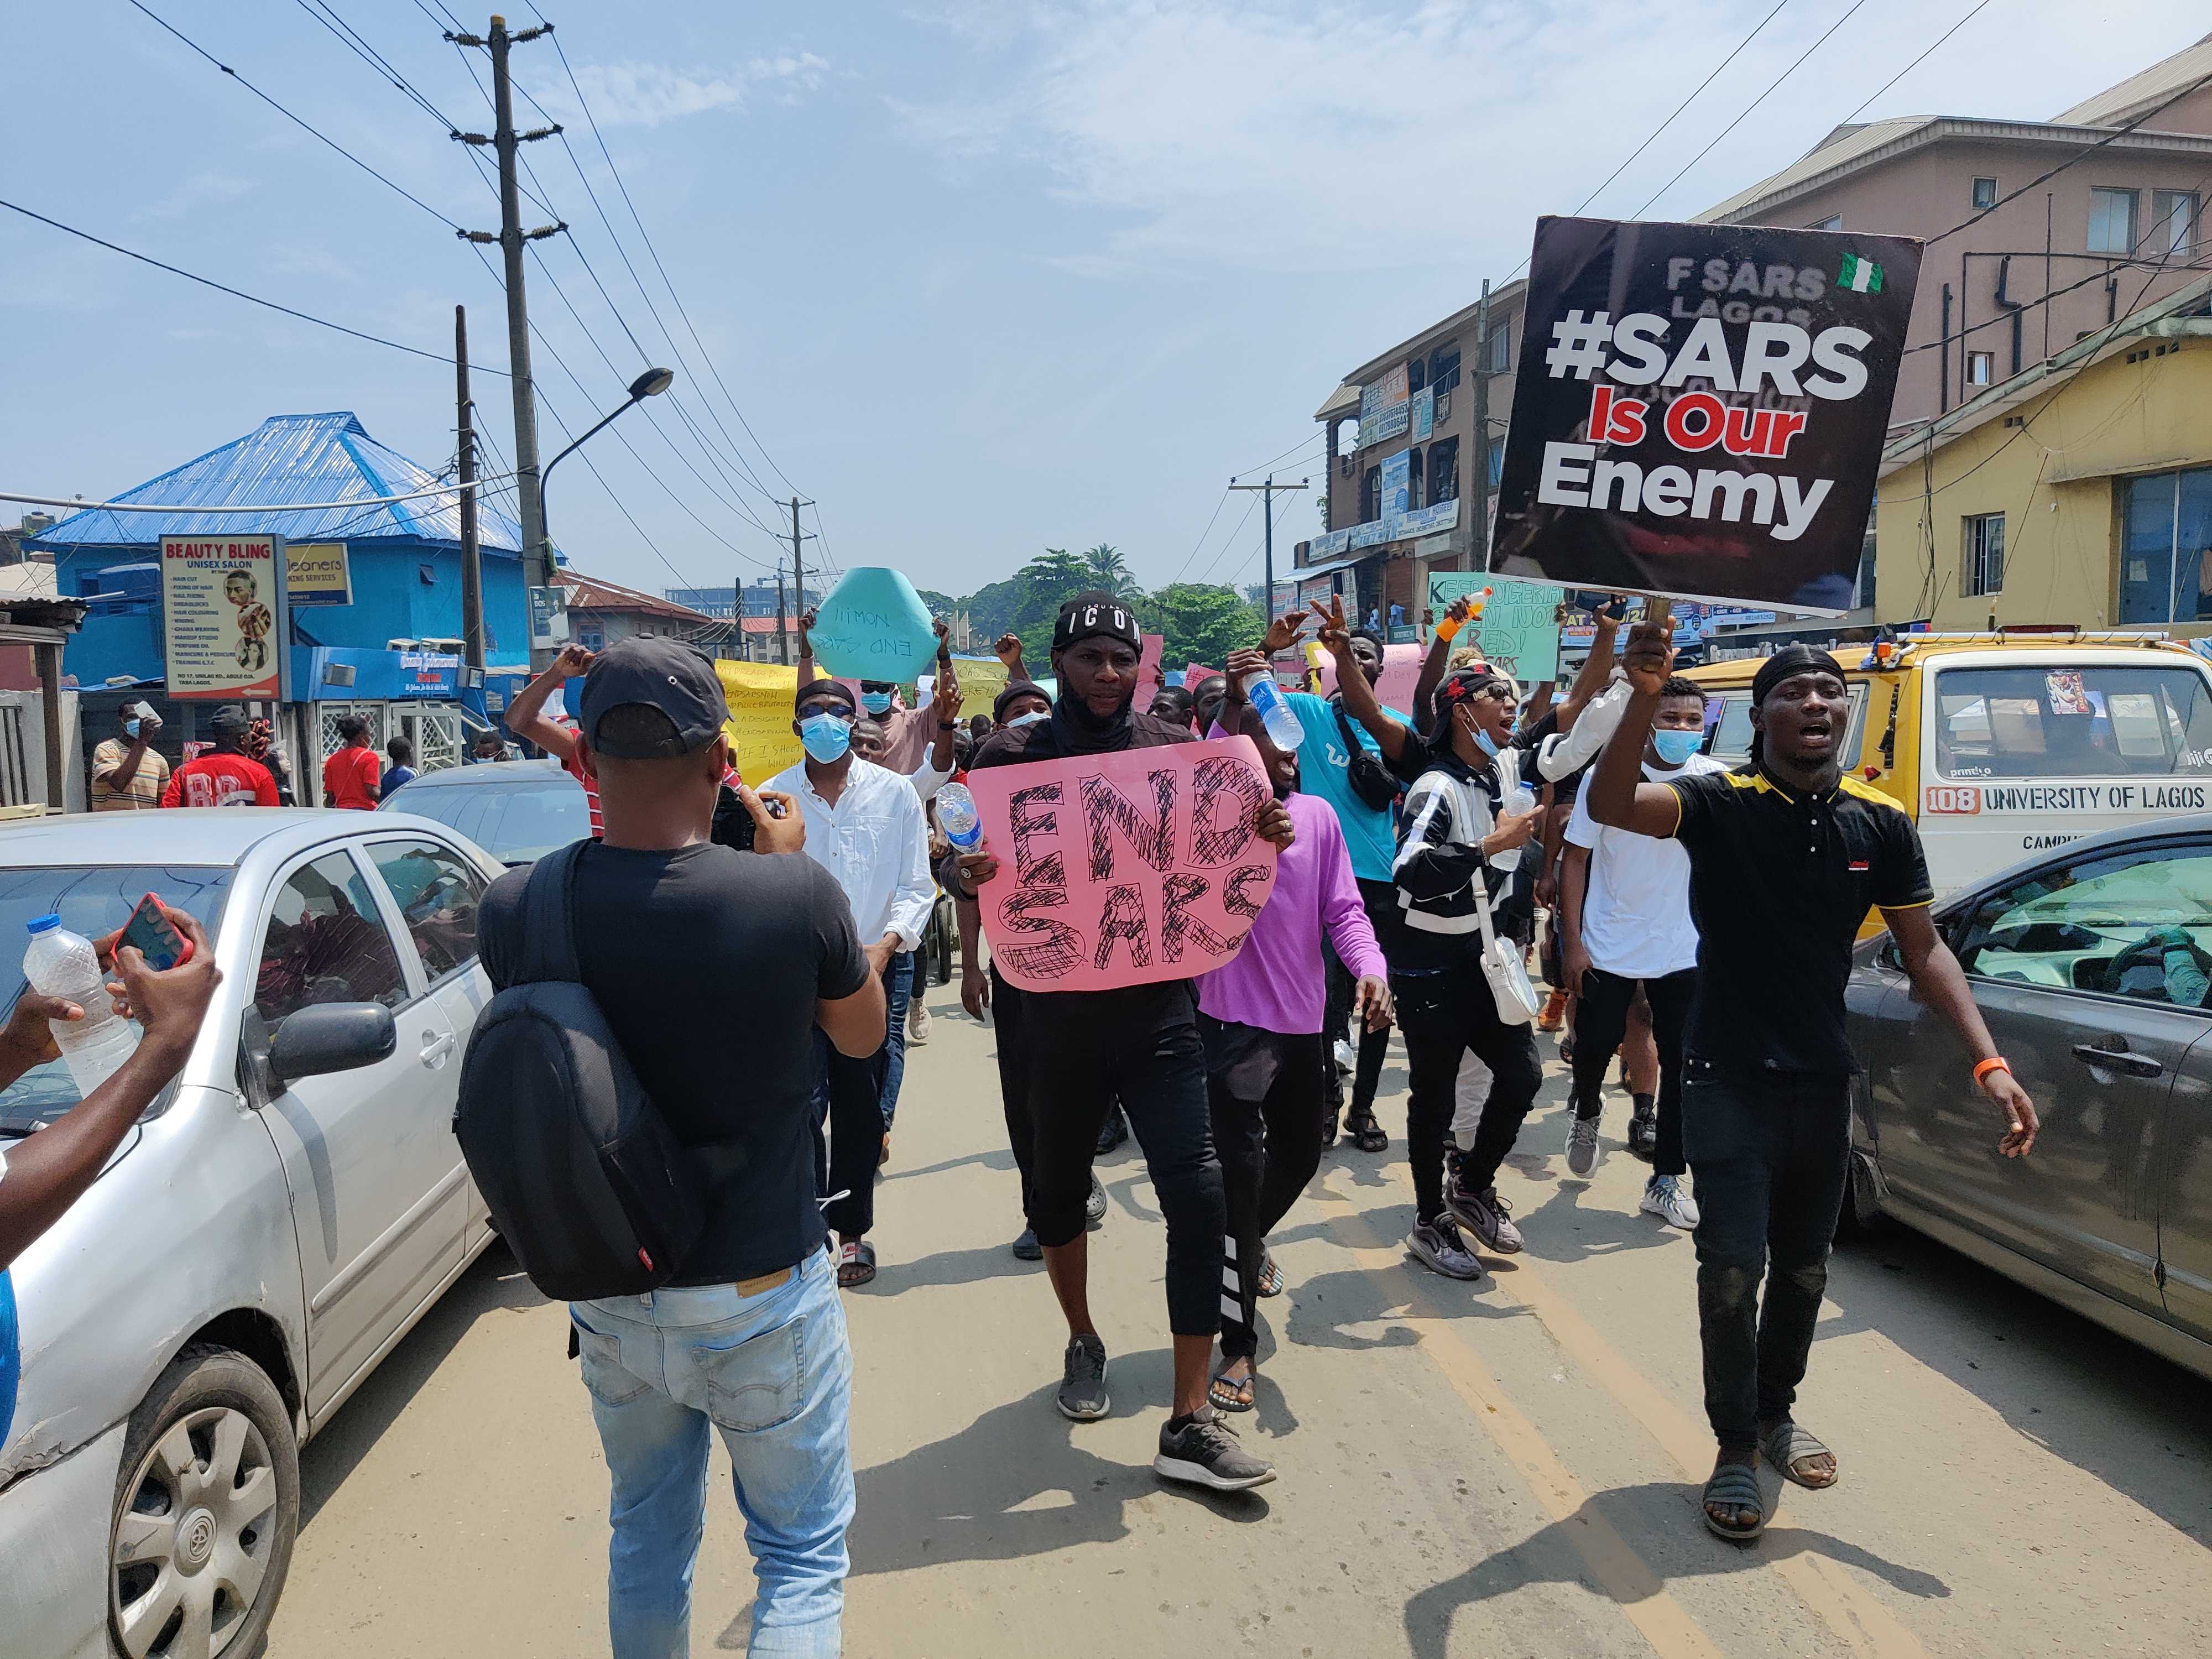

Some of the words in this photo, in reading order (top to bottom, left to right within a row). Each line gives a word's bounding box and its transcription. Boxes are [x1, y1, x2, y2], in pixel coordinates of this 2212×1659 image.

[1666, 257, 1694, 291] F
[1702, 258, 1827, 301] SARS
[1546, 309, 1873, 401] #SARS
[1586, 383, 1650, 446] Is
[1663, 390, 1808, 459] Our
[1537, 441, 1835, 541] Enemy
[166, 544, 223, 559] BEAUTY
[228, 544, 270, 559] BLING
[287, 559, 342, 572] leaners
[1430, 580, 1483, 603] KEEP
[1512, 605, 1558, 629] NOT
[870, 638, 913, 656] END
[1467, 629, 1526, 655] RED!
[772, 744, 801, 756] SHOOT
[1929, 788, 1976, 811] 108
[1985, 786, 2101, 810] UNIVERSITY
[2109, 786, 2135, 808] OF
[2142, 786, 2205, 808] LAGOS
[1009, 757, 1268, 888] END
[2023, 835, 2086, 849] CAMP
[997, 865, 1271, 979] SARS
